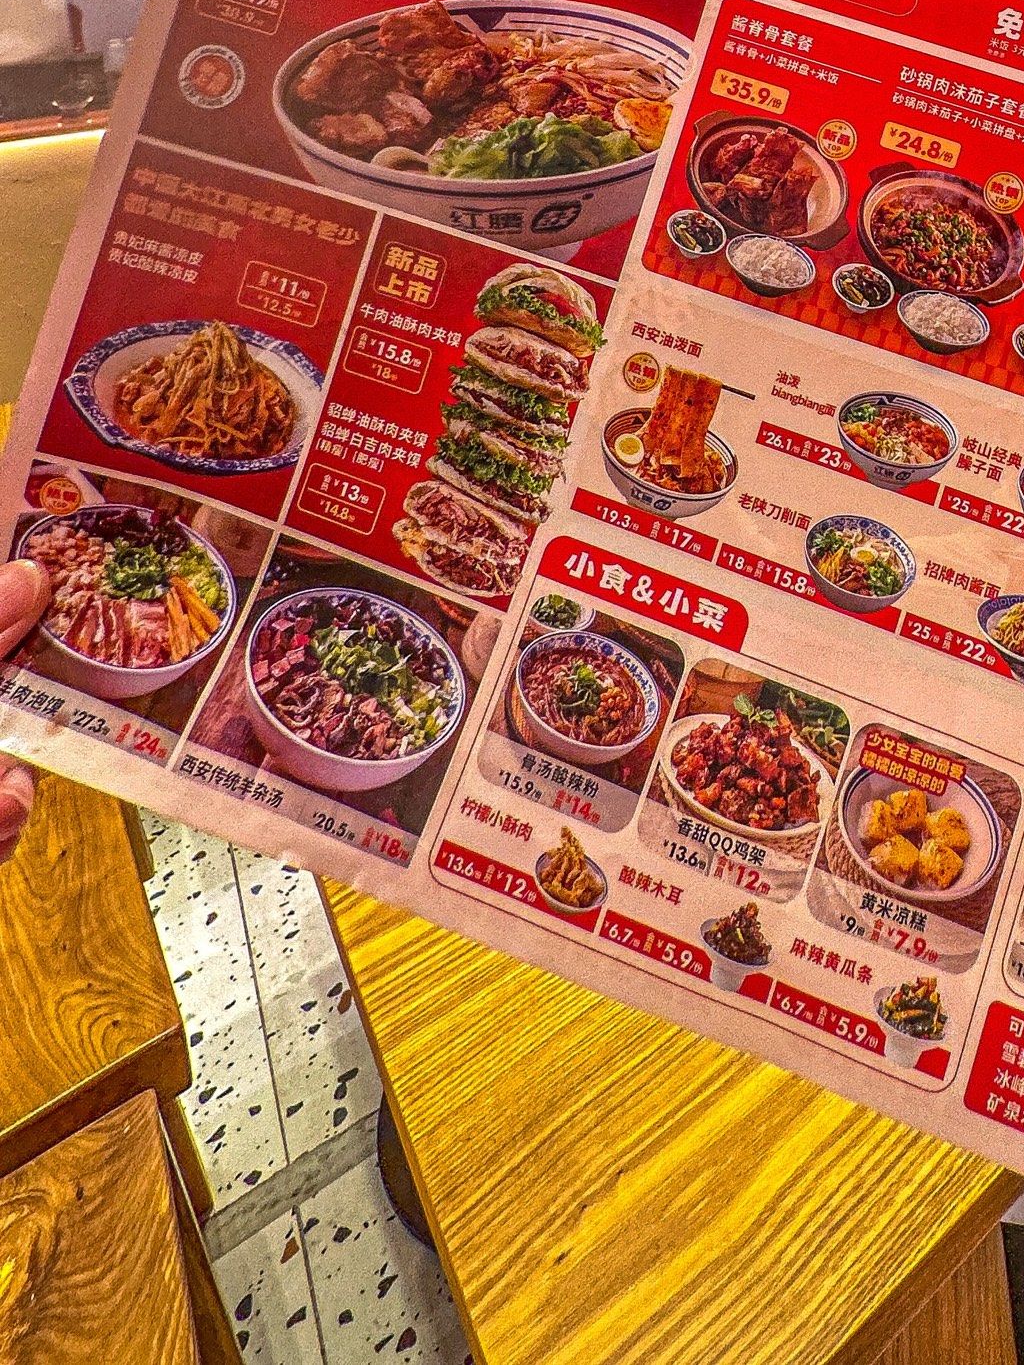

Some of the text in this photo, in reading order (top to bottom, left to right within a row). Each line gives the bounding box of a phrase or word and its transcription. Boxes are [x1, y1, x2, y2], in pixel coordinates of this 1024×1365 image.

[730, 13, 815, 54] 酱脊骨套餐
[988, 36, 1012, 52] 米饭
[716, 73, 785, 111] ¥35.9/份
[886, 126, 955, 164] ¥24.8/份
[384, 245, 440, 281] 新品
[378, 269, 433, 306] 上市
[358, 300, 462, 350] 牛肉油酥肉夹馍
[630, 321, 703, 359] 西安油泼面
[774, 369, 800, 389] 油泼
[320, 419, 422, 469] 貂蝉白吉肉夹馍
[326, 399, 429, 450] 貂蝉油酥肉夹馍
[955, 452, 1003, 483] 臊子面
[960, 434, 1024, 470] 岐山经典
[736, 490, 812, 532] 老陕刀削面
[661, 525, 703, 553] ¥17/份
[561, 546, 729, 634] 小食&小菜
[922, 559, 1002, 602] 招牌肉酱面
[180, 755, 285, 809] 西安传统羊杂汤
[519, 752, 601, 800] 骨汤酸辣粉
[458, 795, 534, 843] 柠檬小酥肉
[676, 817, 766, 867] 香甜QQ鸡架
[493, 869, 539, 903] ¥12/份
[617, 864, 684, 907] 酸辣木耳
[859, 890, 928, 933] 黄米凉糕
[788, 936, 874, 986] 麻辣黄瓜条
